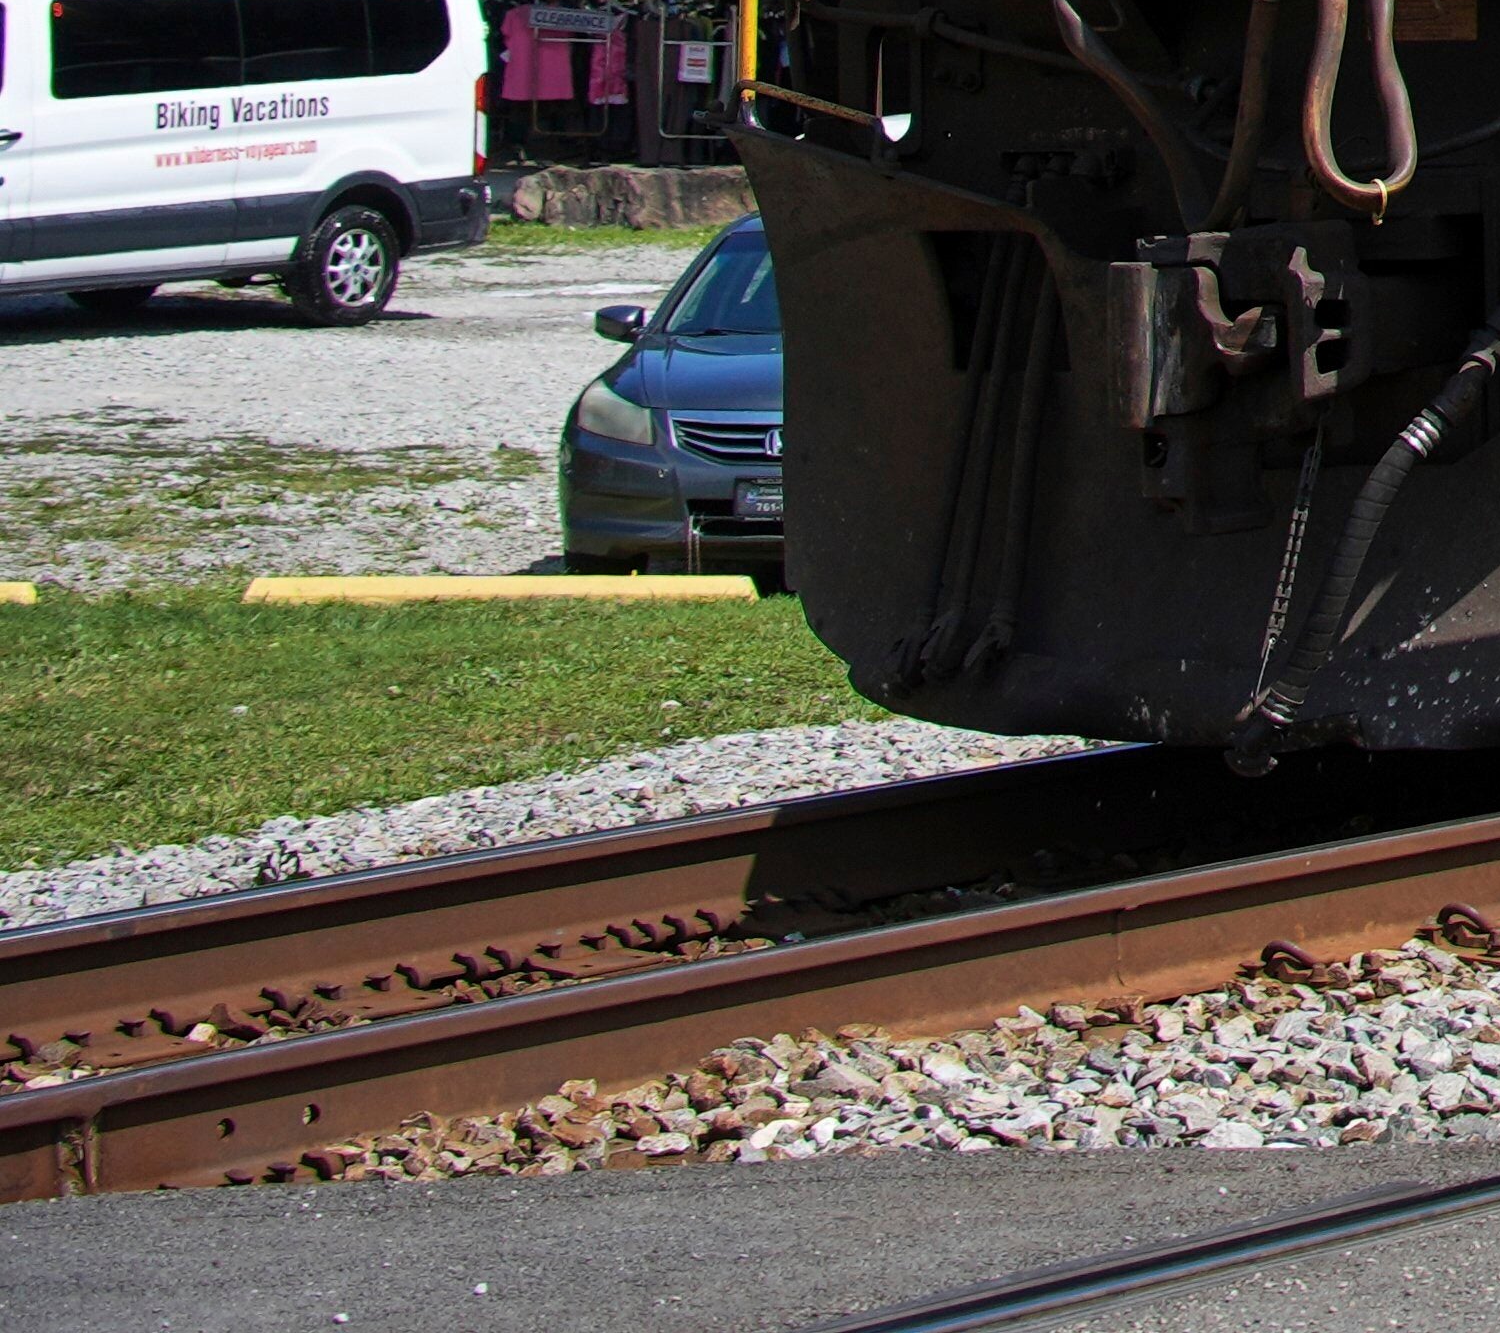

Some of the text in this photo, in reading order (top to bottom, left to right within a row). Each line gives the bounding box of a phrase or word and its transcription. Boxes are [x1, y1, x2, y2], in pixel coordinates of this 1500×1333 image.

[533, 9, 607, 31] CLEARANCE
[155, 93, 330, 131] Biking Vacations
[155, 139, 318, 169] www.wilderness-voyageurs.com
